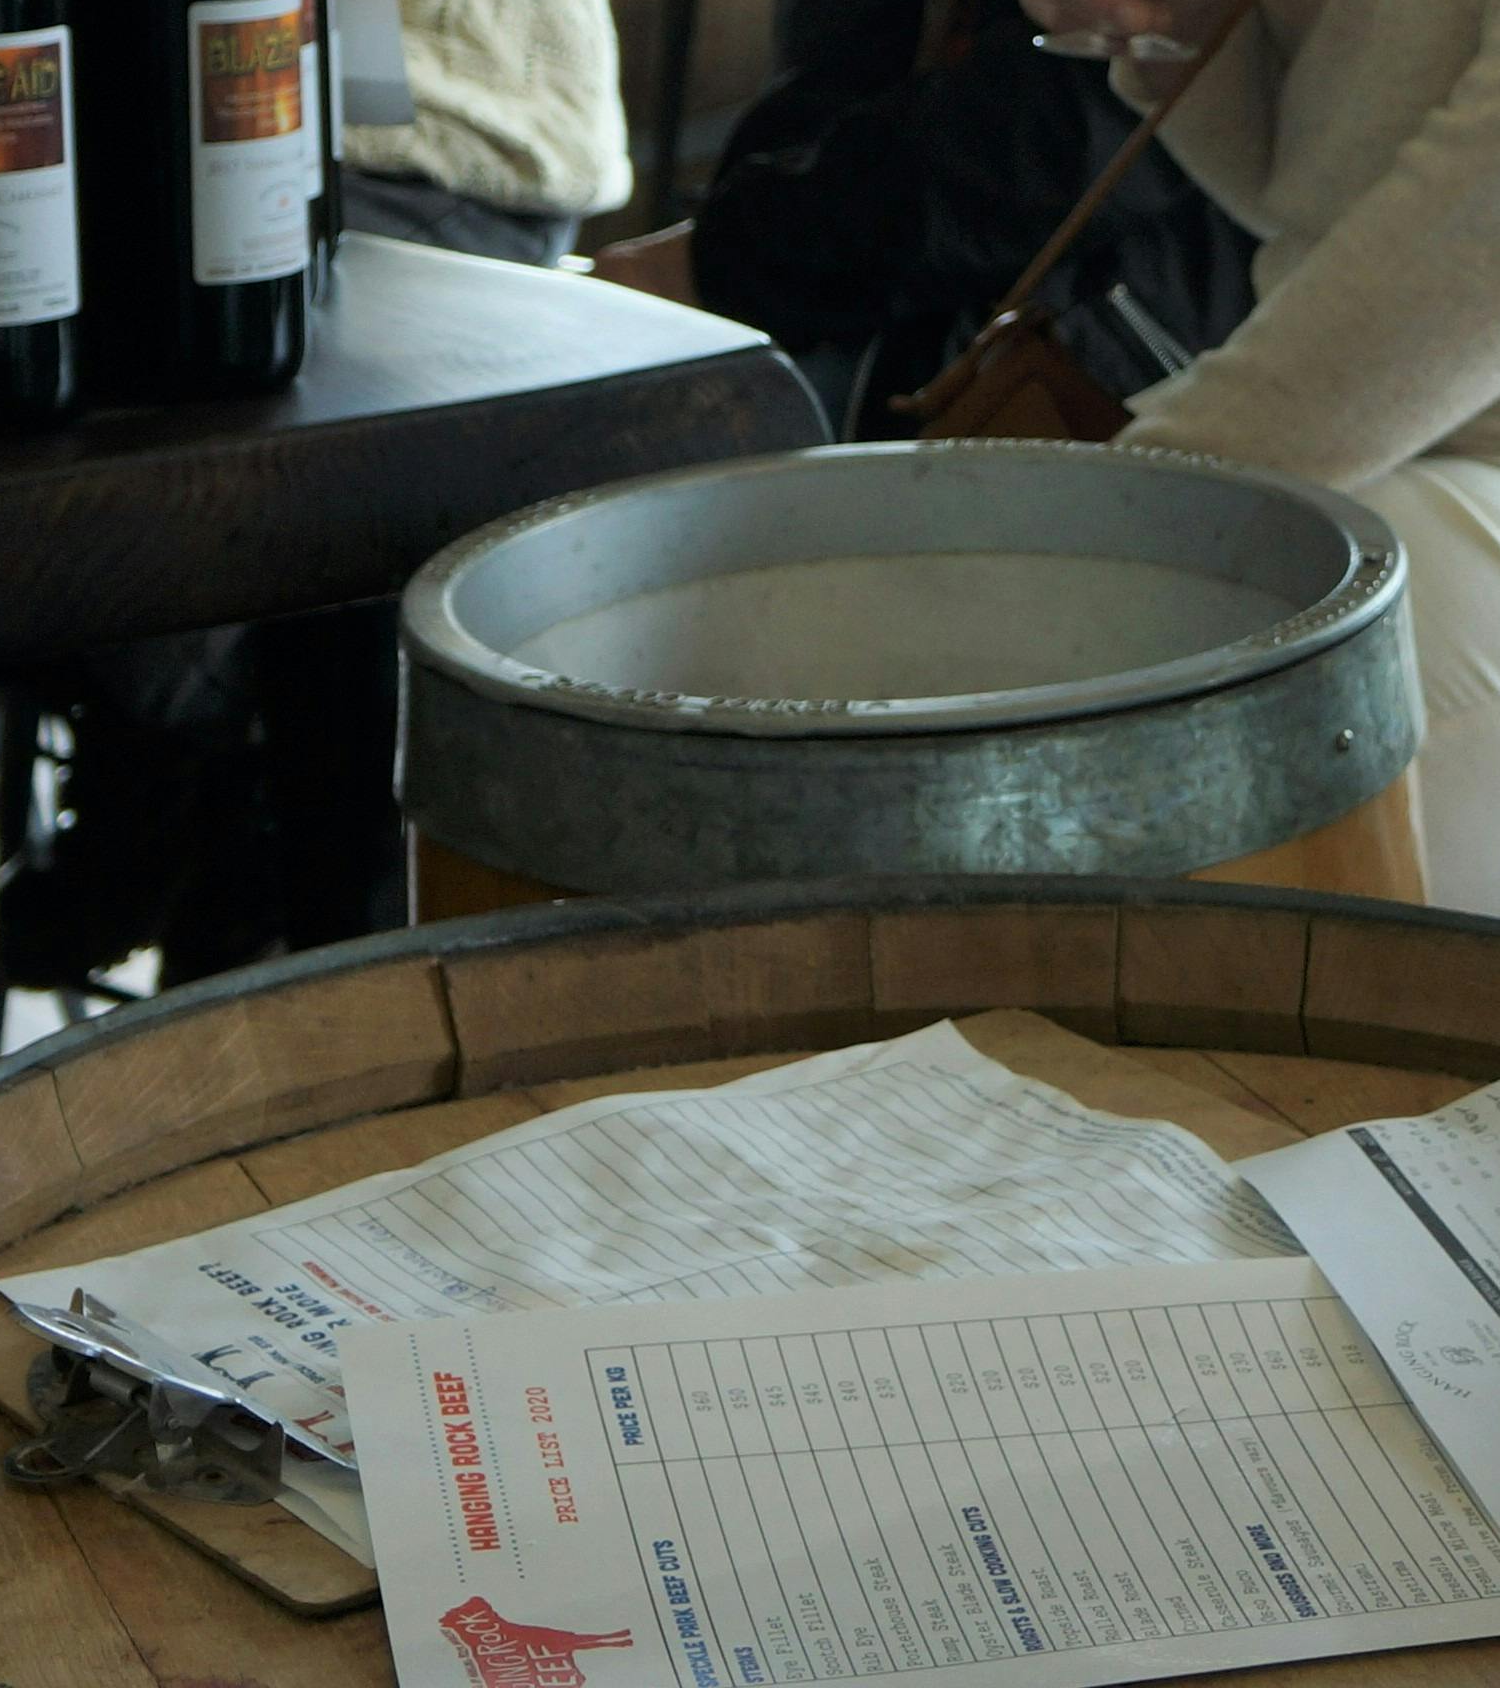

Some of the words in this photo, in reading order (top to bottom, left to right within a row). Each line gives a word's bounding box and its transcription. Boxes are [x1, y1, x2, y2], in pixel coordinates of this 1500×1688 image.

[199, 1262, 263, 1298] BEEF?
[253, 1294, 306, 1330] ROCK
[275, 1282, 332, 1319] MORE
[1087, 1361, 1111, 1383] $20
[1122, 1358, 1146, 1380] $20
[1193, 1353, 1219, 1375] $20
[1227, 1351, 1252, 1373] $30
[1263, 1349, 1288, 1369] $60
[1298, 1346, 1323, 1367] $60
[603, 1365, 627, 1382] KG
[872, 1376, 896, 1399] $30
[944, 1371, 969, 1394] $20
[980, 1368, 1005, 1391] $20
[1017, 1367, 1041, 1389] $20
[1052, 1364, 1076, 1385] $20
[433, 1371, 469, 1415] BEEF
[524, 1386, 552, 1422] 2020
[609, 1385, 634, 1409] PER
[690, 1390, 714, 1412] $60
[727, 1387, 749, 1409] $50
[764, 1385, 786, 1407] $45
[800, 1382, 824, 1404] $45
[837, 1379, 860, 1402] $40
[443, 1421, 482, 1465] ROCK
[615, 1411, 645, 1446] PRICE
[537, 1431, 564, 1467] LIST
[453, 1472, 502, 1550] HANGING
[547, 1476, 578, 1523] PRICE
[1417, 1491, 1446, 1516] Meat
[960, 1506, 988, 1531] CUTS
[1245, 1523, 1276, 1550] MORE
[1283, 1518, 1325, 1568] Sausages
[1436, 1519, 1469, 1551] Mince
[651, 1538, 682, 1571] CUTS
[935, 1543, 965, 1576] Steak
[971, 1534, 1007, 1575] COOKING
[1173, 1537, 1205, 1569] Steak
[1261, 1550, 1289, 1572] AND
[663, 1575, 691, 1604] BEEF
[861, 1557, 891, 1591] Steak
[1028, 1567, 1058, 1599] Roast
[1071, 1569, 1100, 1600] Roast
[1112, 1572, 1141, 1601] Roast
[1234, 1568, 1260, 1594] Buco
[1349, 1561, 1393, 1608] Pastrami
[1424, 1555, 1469, 1599] Bresaola
[1458, 1554, 1500, 1594] Premium
[952, 1582, 983, 1614] Blade
[992, 1578, 1021, 1604] SLOW
[1194, 1573, 1238, 1628] Casserole
[1272, 1572, 1318, 1619] SAUSAGES
[1315, 1571, 1355, 1613] Gourmet
[672, 1607, 702, 1638] PARK
[794, 1592, 825, 1631] Fillet
[919, 1599, 949, 1630] Steak
[1045, 1603, 1084, 1645] Topside
[1085, 1604, 1121, 1640] Rolled
[1129, 1607, 1161, 1636] Blade
[1164, 1594, 1200, 1633] Corned
[762, 1616, 794, 1654] Fillet
[848, 1626, 877, 1646] Eye
[878, 1597, 924, 1666] Porterhouse
[970, 1620, 1008, 1656] Oyster
[1011, 1616, 1044, 1651] ROASTS
[682, 1640, 719, 1686] SPECKLE
[732, 1646, 765, 1683] STEAKS
[812, 1637, 842, 1675] Scotch
[858, 1651, 884, 1671] Rib
[937, 1636, 965, 1661] Rump
[779, 1660, 808, 1679] Eye
